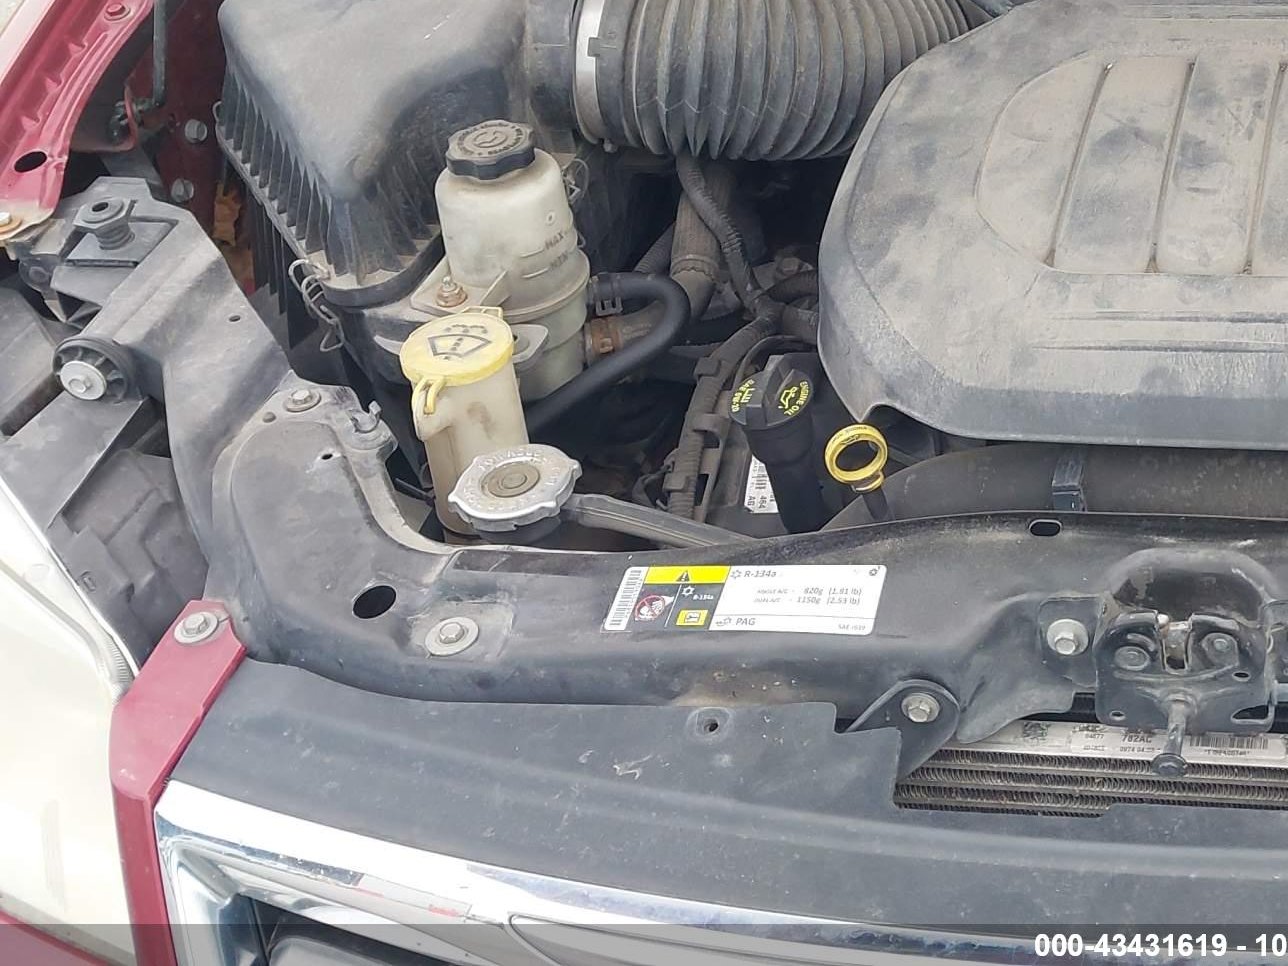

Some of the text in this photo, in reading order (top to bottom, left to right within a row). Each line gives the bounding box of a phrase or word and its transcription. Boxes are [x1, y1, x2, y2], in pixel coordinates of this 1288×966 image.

[784, 381, 810, 416] ENGINE OIL
[744, 570, 777, 578] R-134a
[804, 587, 823, 596] 820g
[735, 617, 756, 626] PAG
